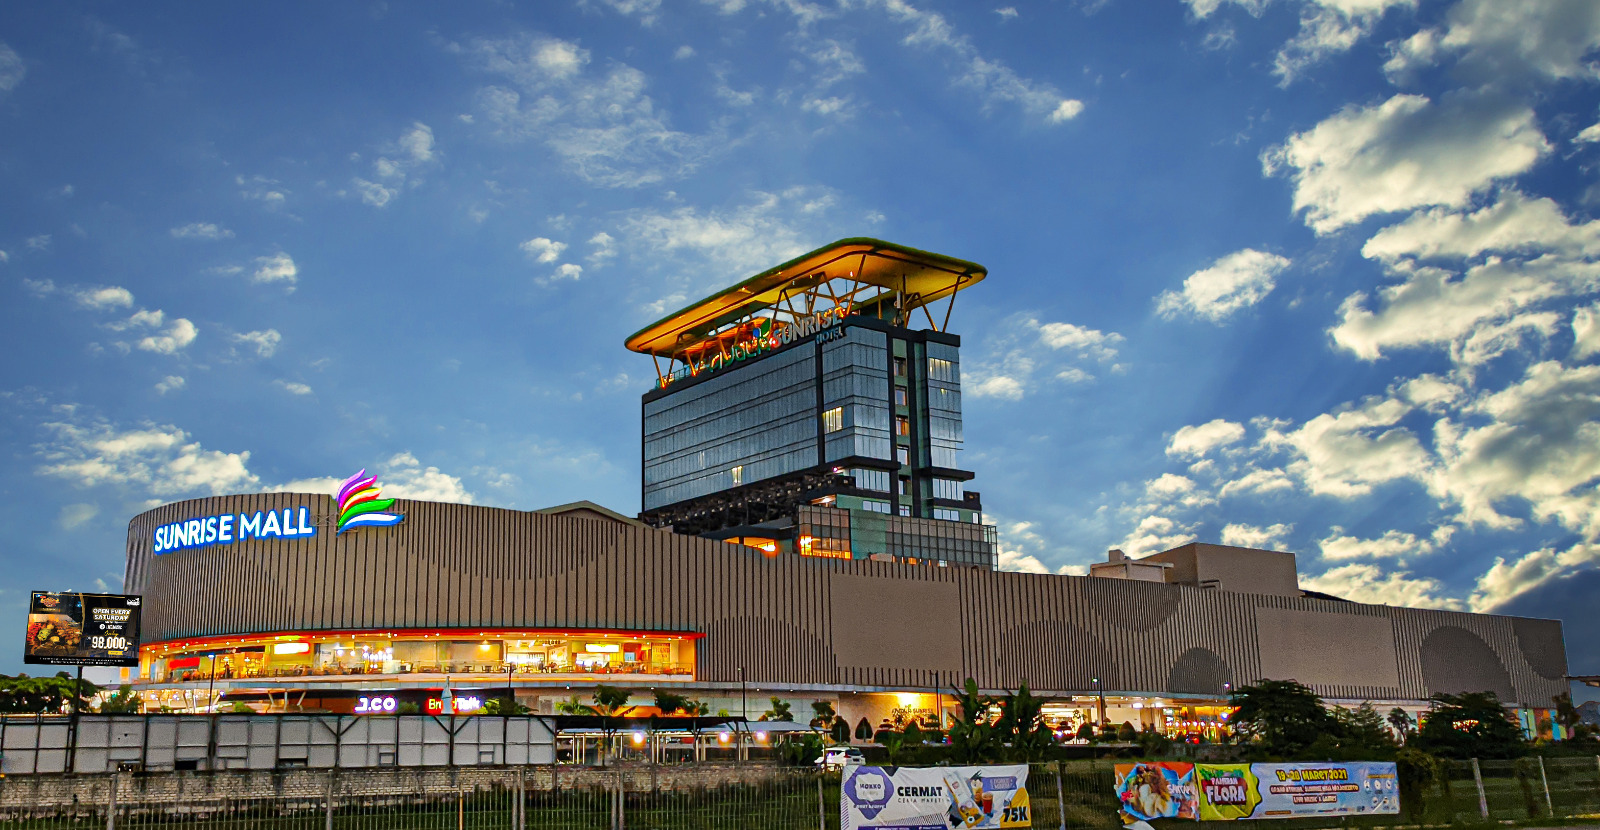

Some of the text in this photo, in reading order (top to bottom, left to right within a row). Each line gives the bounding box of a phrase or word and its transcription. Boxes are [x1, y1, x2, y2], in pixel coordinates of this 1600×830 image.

[772, 308, 843, 349] SUNRISE
[154, 507, 313, 553] SUNRISE MALL
[354, 697, 396, 712] J.CO
[1329, 768, 1348, 780] 2021
[897, 786, 943, 797] CERMAT
[1206, 785, 1246, 804] FLORA
[1003, 806, 1029, 822] 75K
